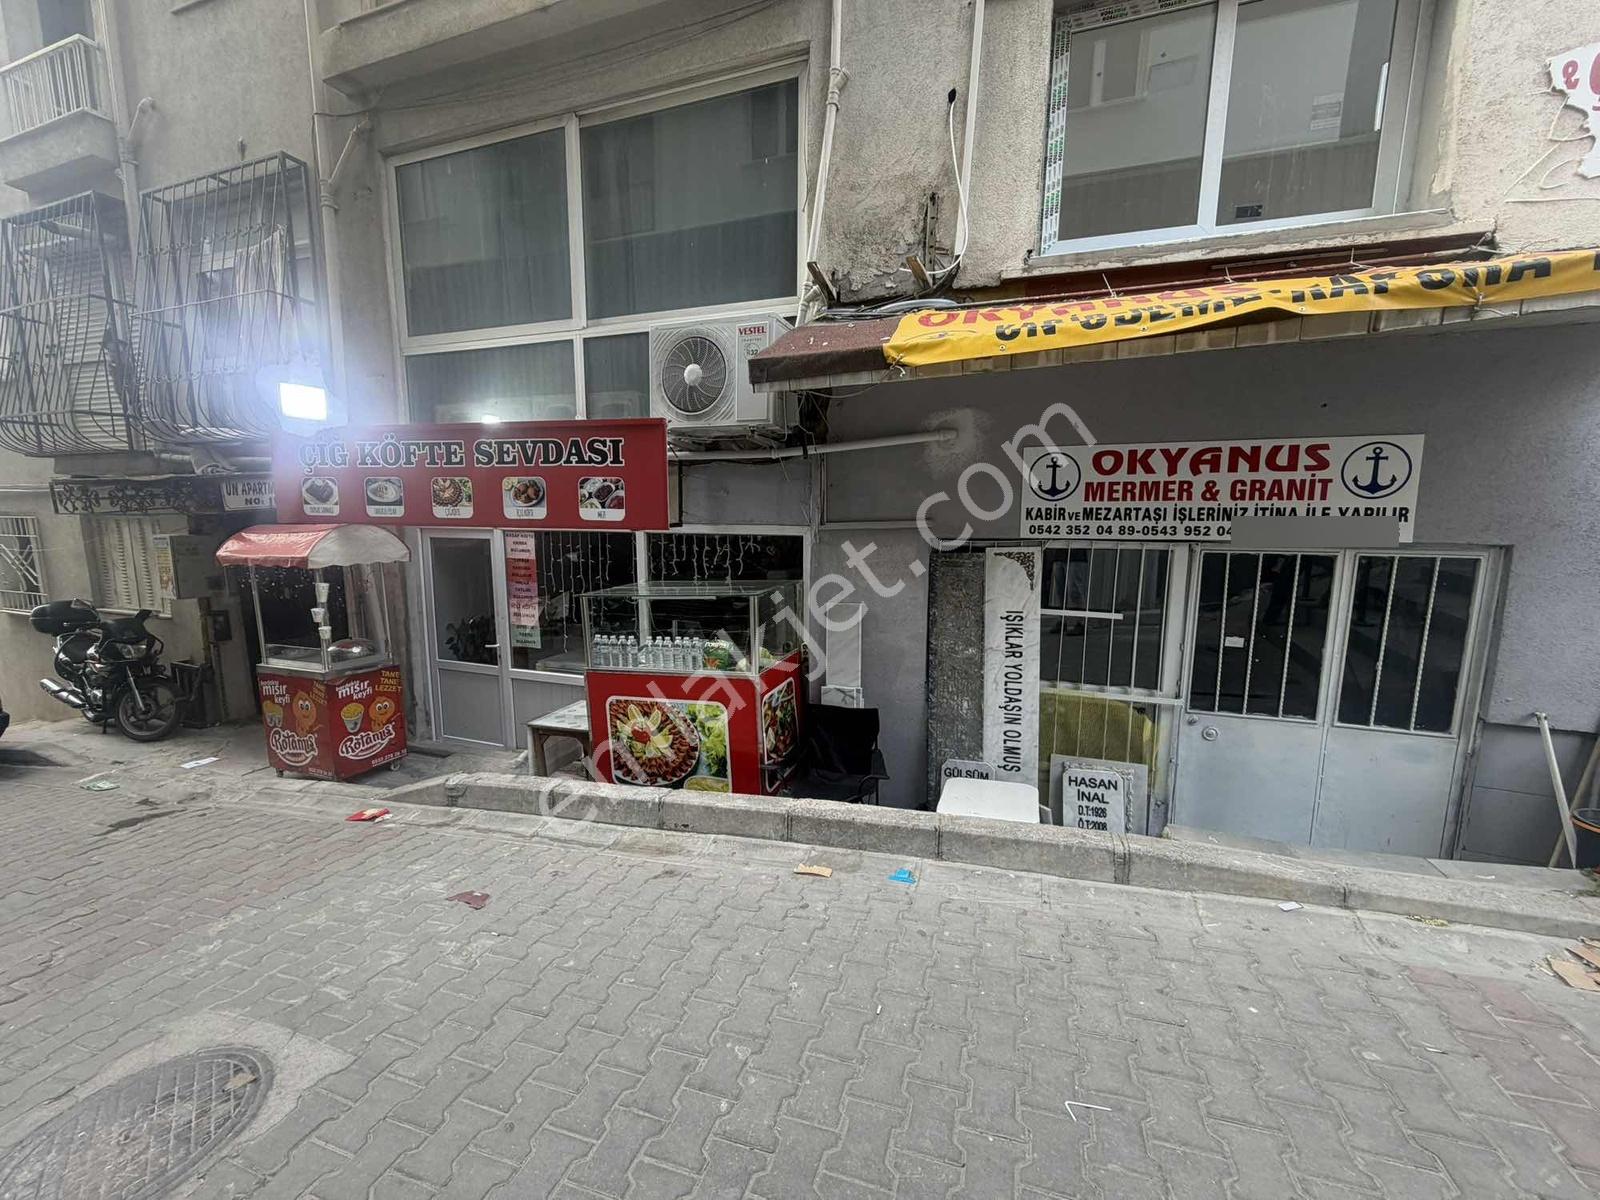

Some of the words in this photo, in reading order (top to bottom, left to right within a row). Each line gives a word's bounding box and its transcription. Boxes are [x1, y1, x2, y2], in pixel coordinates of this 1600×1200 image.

[738, 326, 767, 336] VESTEL
[357, 432, 465, 468] KÖFTE
[474, 436, 625, 467] SEVDASI
[1092, 443, 1331, 477] OKYANUS
[241, 482, 272, 496] APART
[1083, 480, 1194, 503] MERMER
[1200, 479, 1221, 502] &
[1230, 473, 1334, 501] GRANİT
[1025, 504, 1067, 521] KABİR
[1082, 506, 1168, 525] MEZARTAŞI
[1028, 525, 1061, 536] 0542
[1066, 525, 1090, 536] 352
[1096, 525, 1114, 536] 04
[1118, 525, 1178, 537] 89-0543
[1183, 526, 1211, 537] 952
[1000, 610, 1024, 659] IŞIKLAR
[998, 663, 1023, 726] YOLDAŞIN
[997, 729, 1022, 773] OLMUŞ
[1068, 776, 1118, 791] HASAN
[1077, 788, 1110, 805] İNAL
